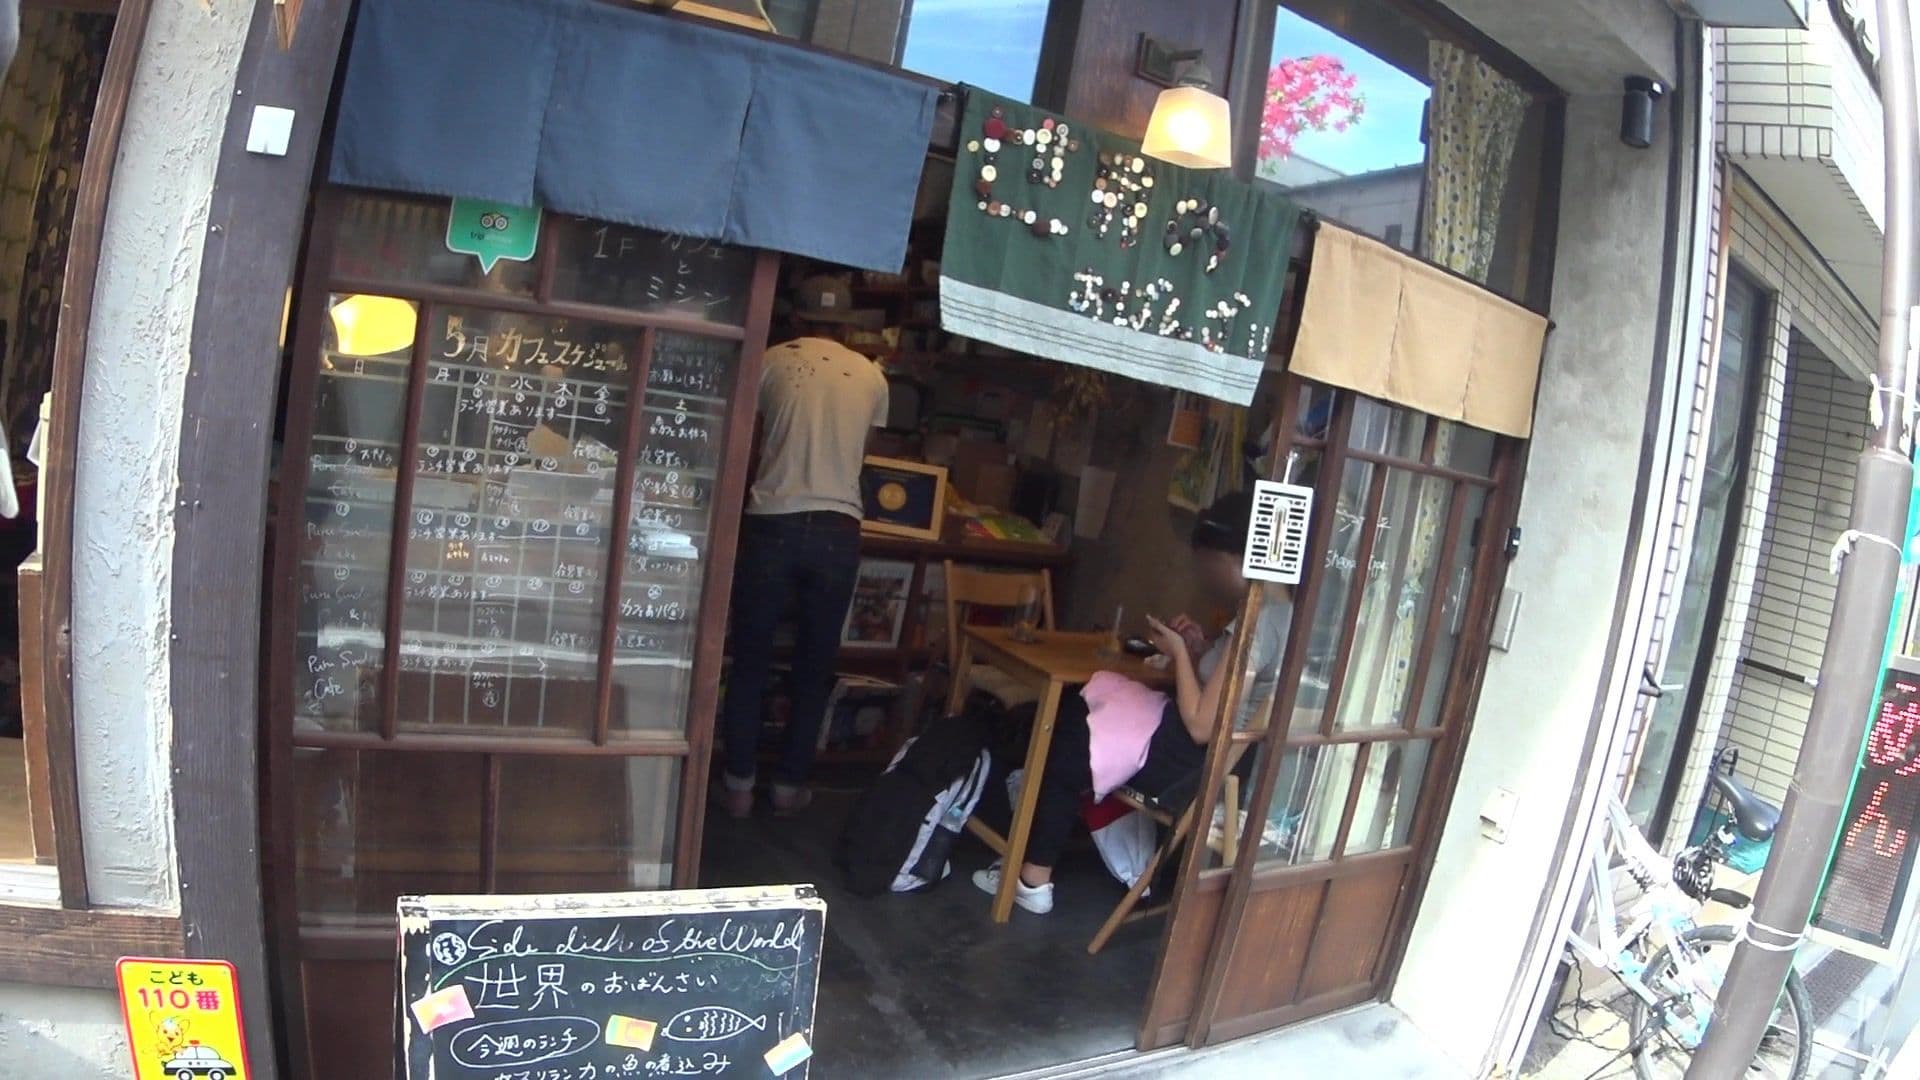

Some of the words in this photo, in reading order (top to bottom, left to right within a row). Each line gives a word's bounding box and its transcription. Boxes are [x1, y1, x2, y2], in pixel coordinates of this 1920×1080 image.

[647, 275, 730, 306] ミシン
[435, 367, 450, 382] 月
[473, 372, 490, 387] 火
[511, 375, 533, 390] 水
[555, 382, 573, 397] 木
[594, 384, 610, 404] 金
[675, 399, 688, 411] 土
[467, 920, 539, 958] Side
[150, 970, 204, 986] こども
[138, 988, 219, 1010] 110番
[467, 1027, 578, 1059] 今週のランチ
